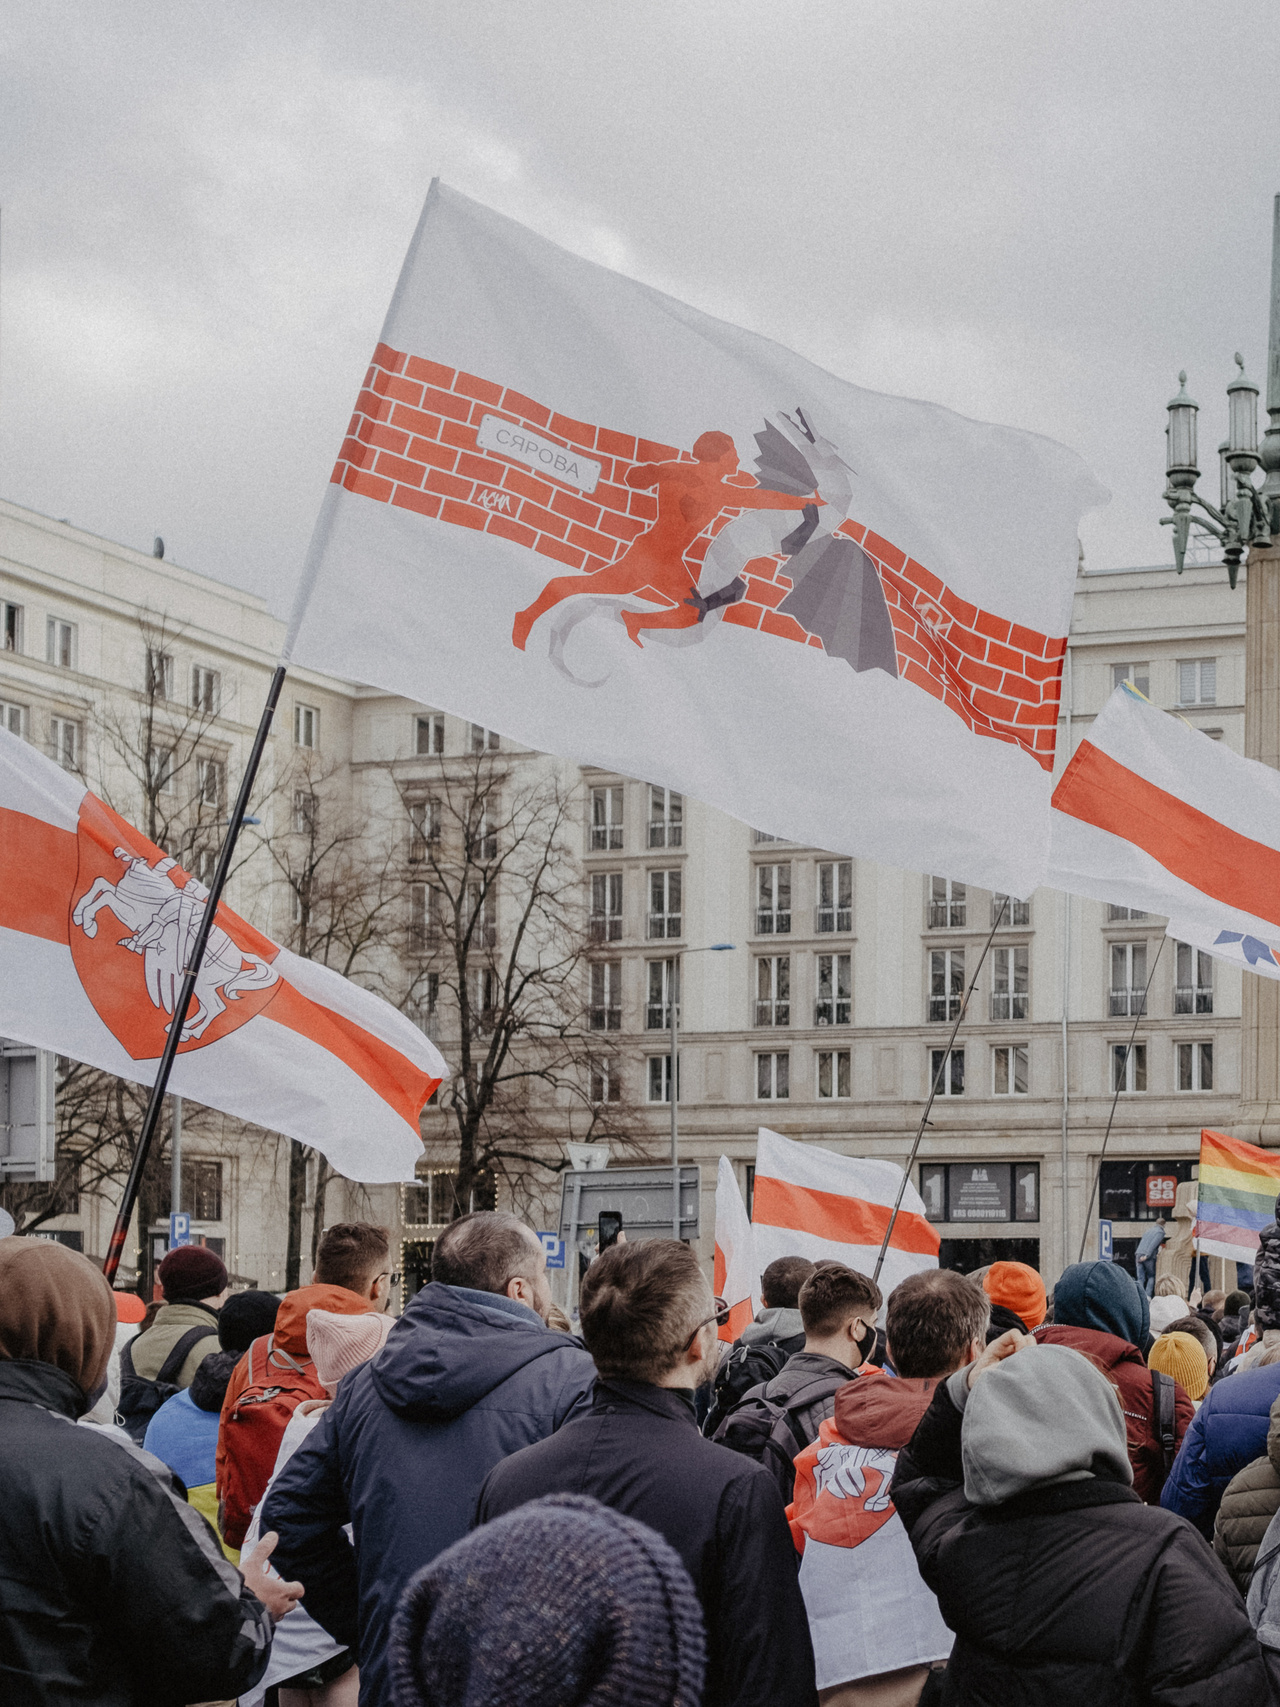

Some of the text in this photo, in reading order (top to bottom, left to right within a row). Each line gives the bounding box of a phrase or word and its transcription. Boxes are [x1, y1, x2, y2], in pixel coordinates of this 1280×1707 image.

[496, 429, 579, 479] СЯРОВА
[175, 1216, 187, 1239] P
[542, 1235, 559, 1256] P
